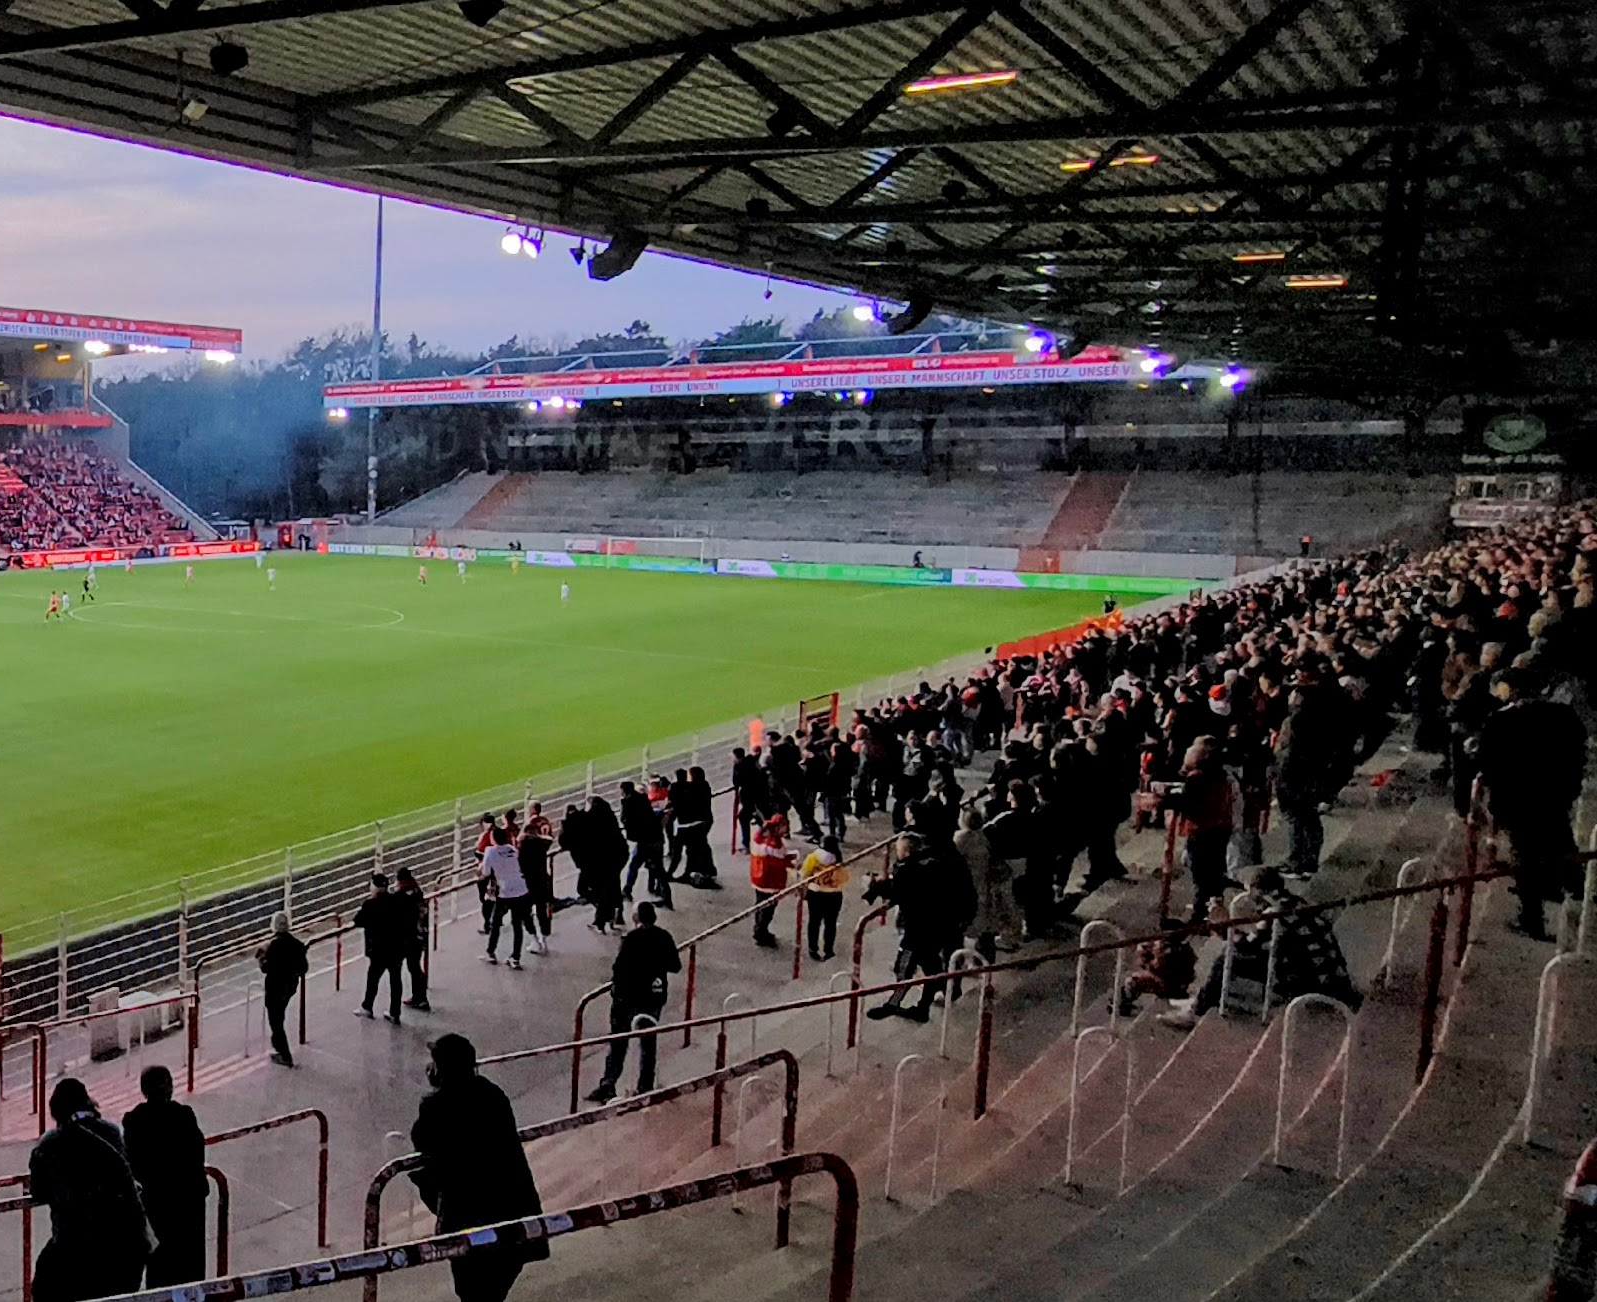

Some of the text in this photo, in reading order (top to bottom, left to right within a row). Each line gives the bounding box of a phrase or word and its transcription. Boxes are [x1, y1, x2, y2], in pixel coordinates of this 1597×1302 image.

[791, 376, 829, 389] UNSERE
[867, 374, 907, 386] UNSERE
[993, 368, 1031, 381] UNSER
[1078, 364, 1119, 377] UNSER
